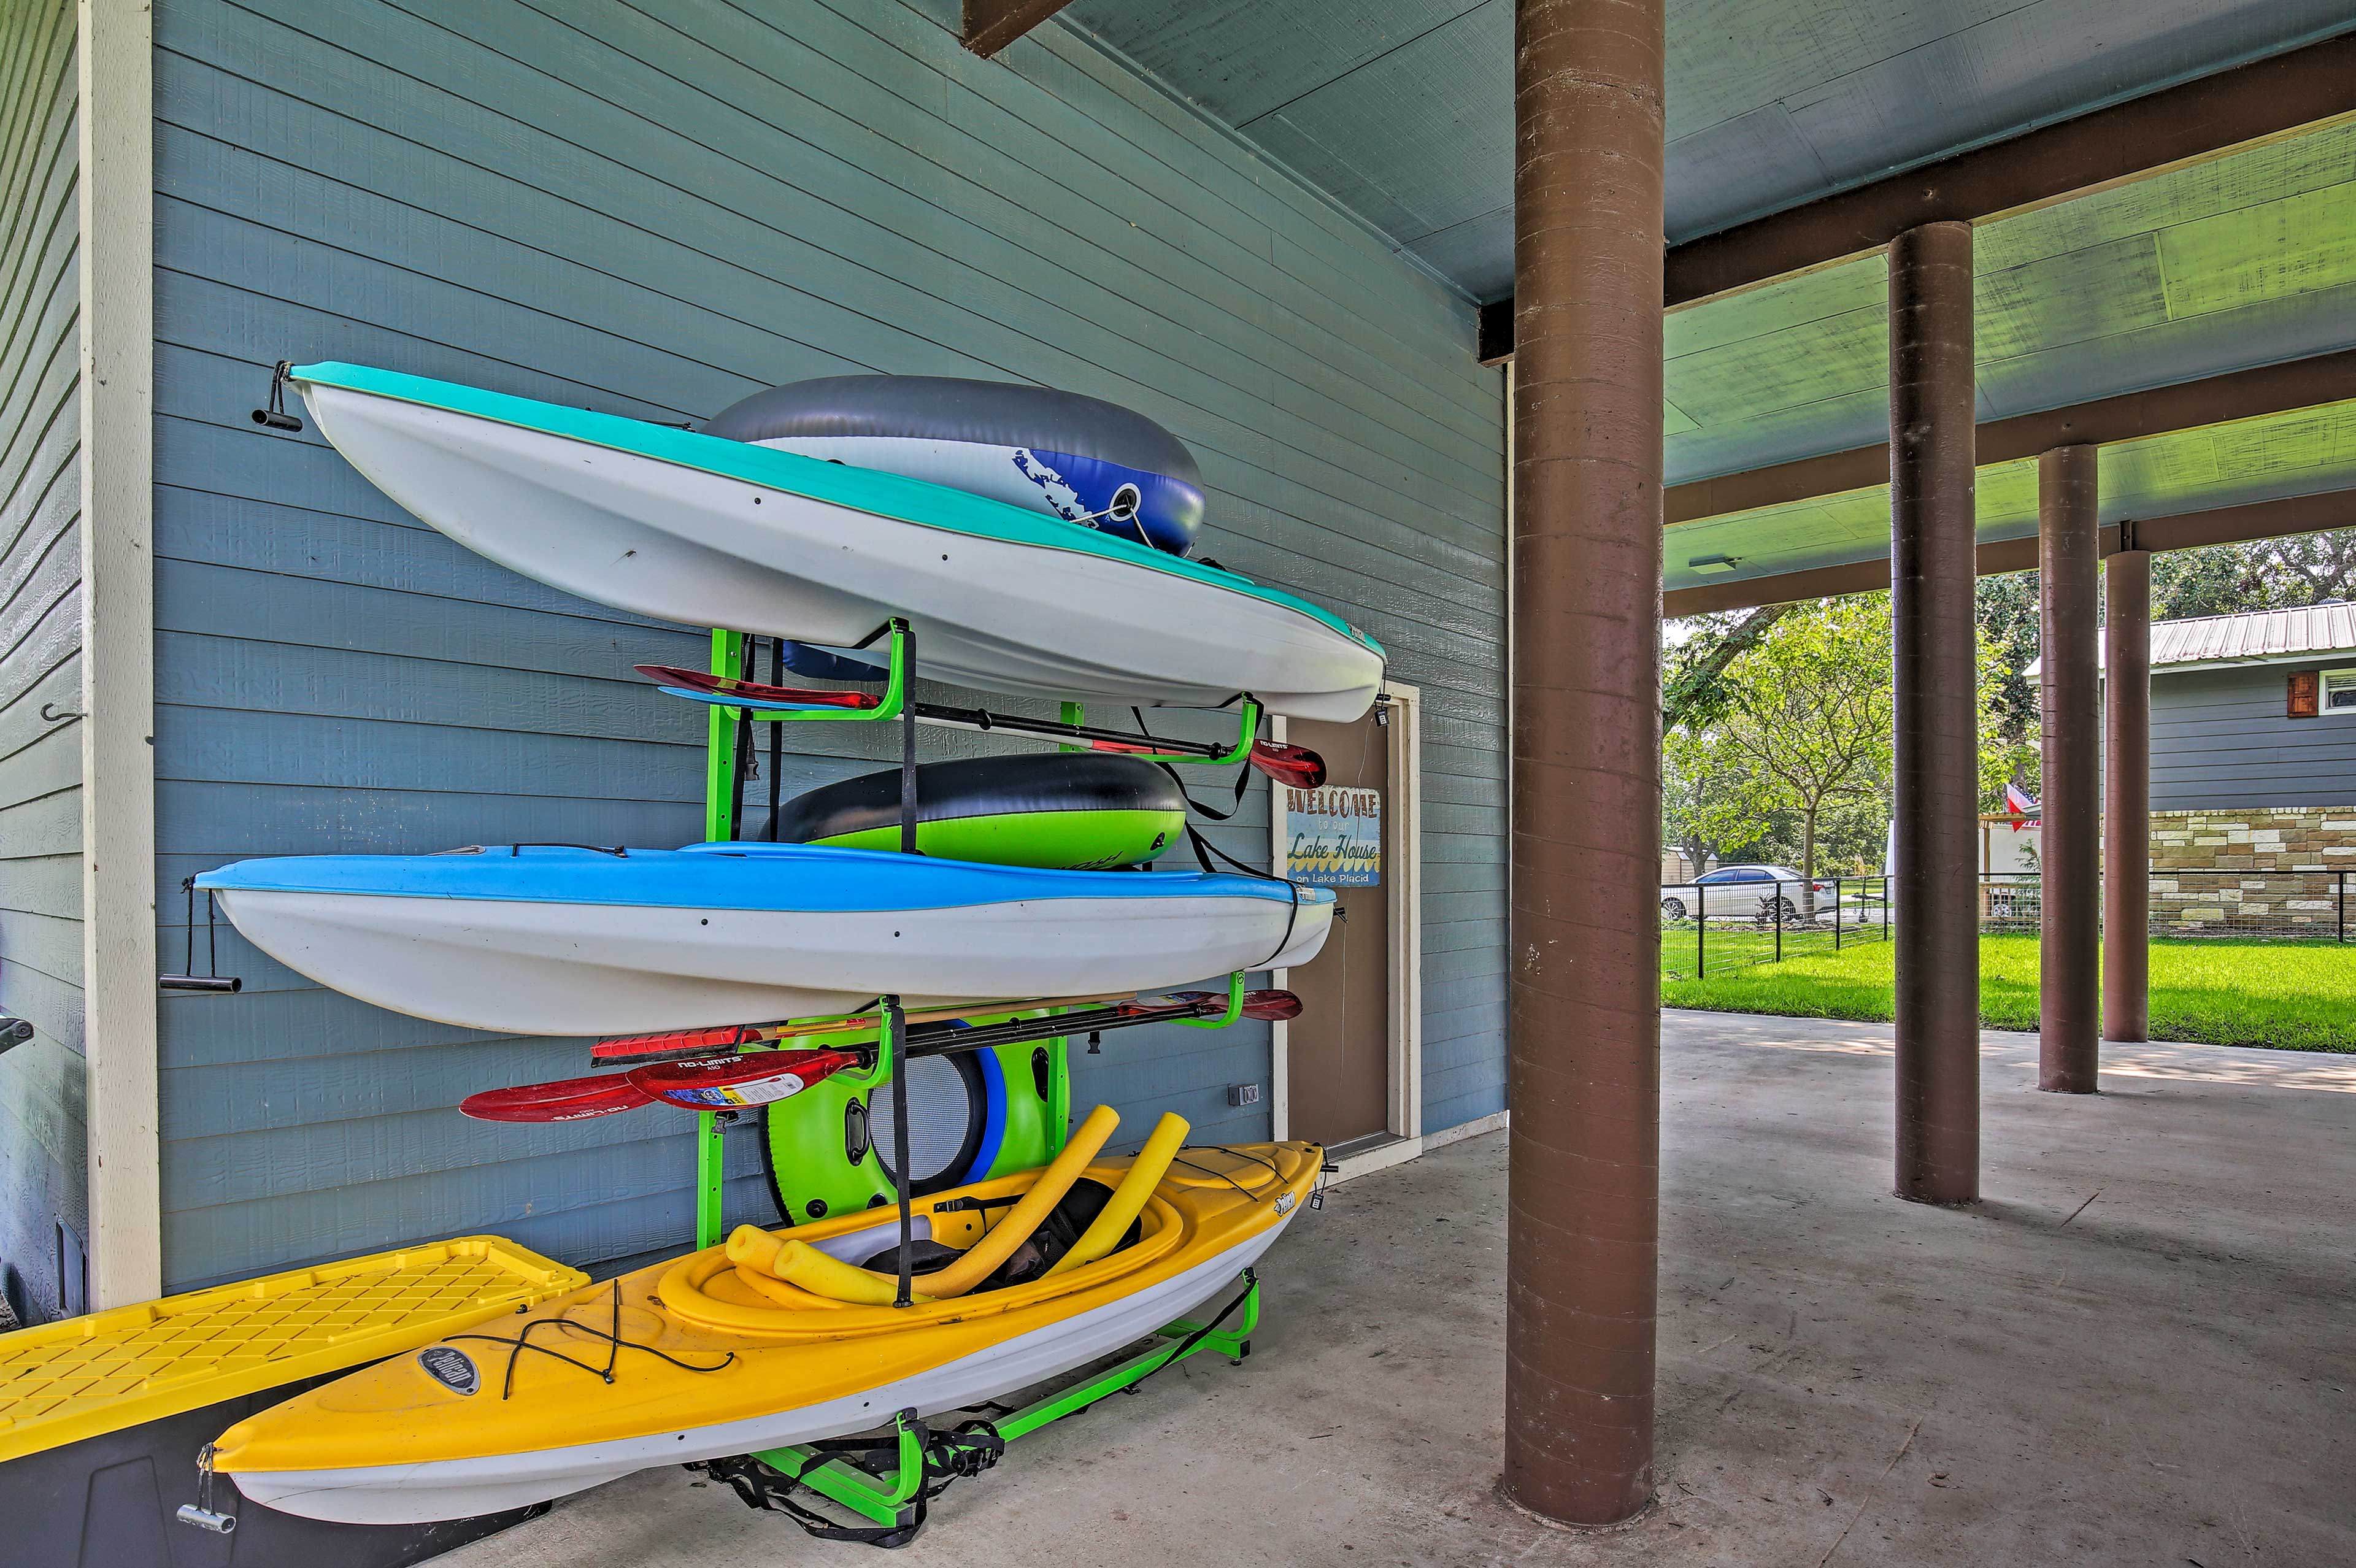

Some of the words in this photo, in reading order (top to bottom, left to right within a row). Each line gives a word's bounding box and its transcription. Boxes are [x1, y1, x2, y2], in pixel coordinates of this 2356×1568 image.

[1287, 789, 1377, 818] WELCOME
[1319, 818, 1328, 830] to
[1333, 820, 1349, 832] our
[1288, 832, 1329, 859] Lake
[1333, 834, 1377, 859] House
[1313, 874, 1336, 883] Lake
[1339, 874, 1369, 883] Placid
